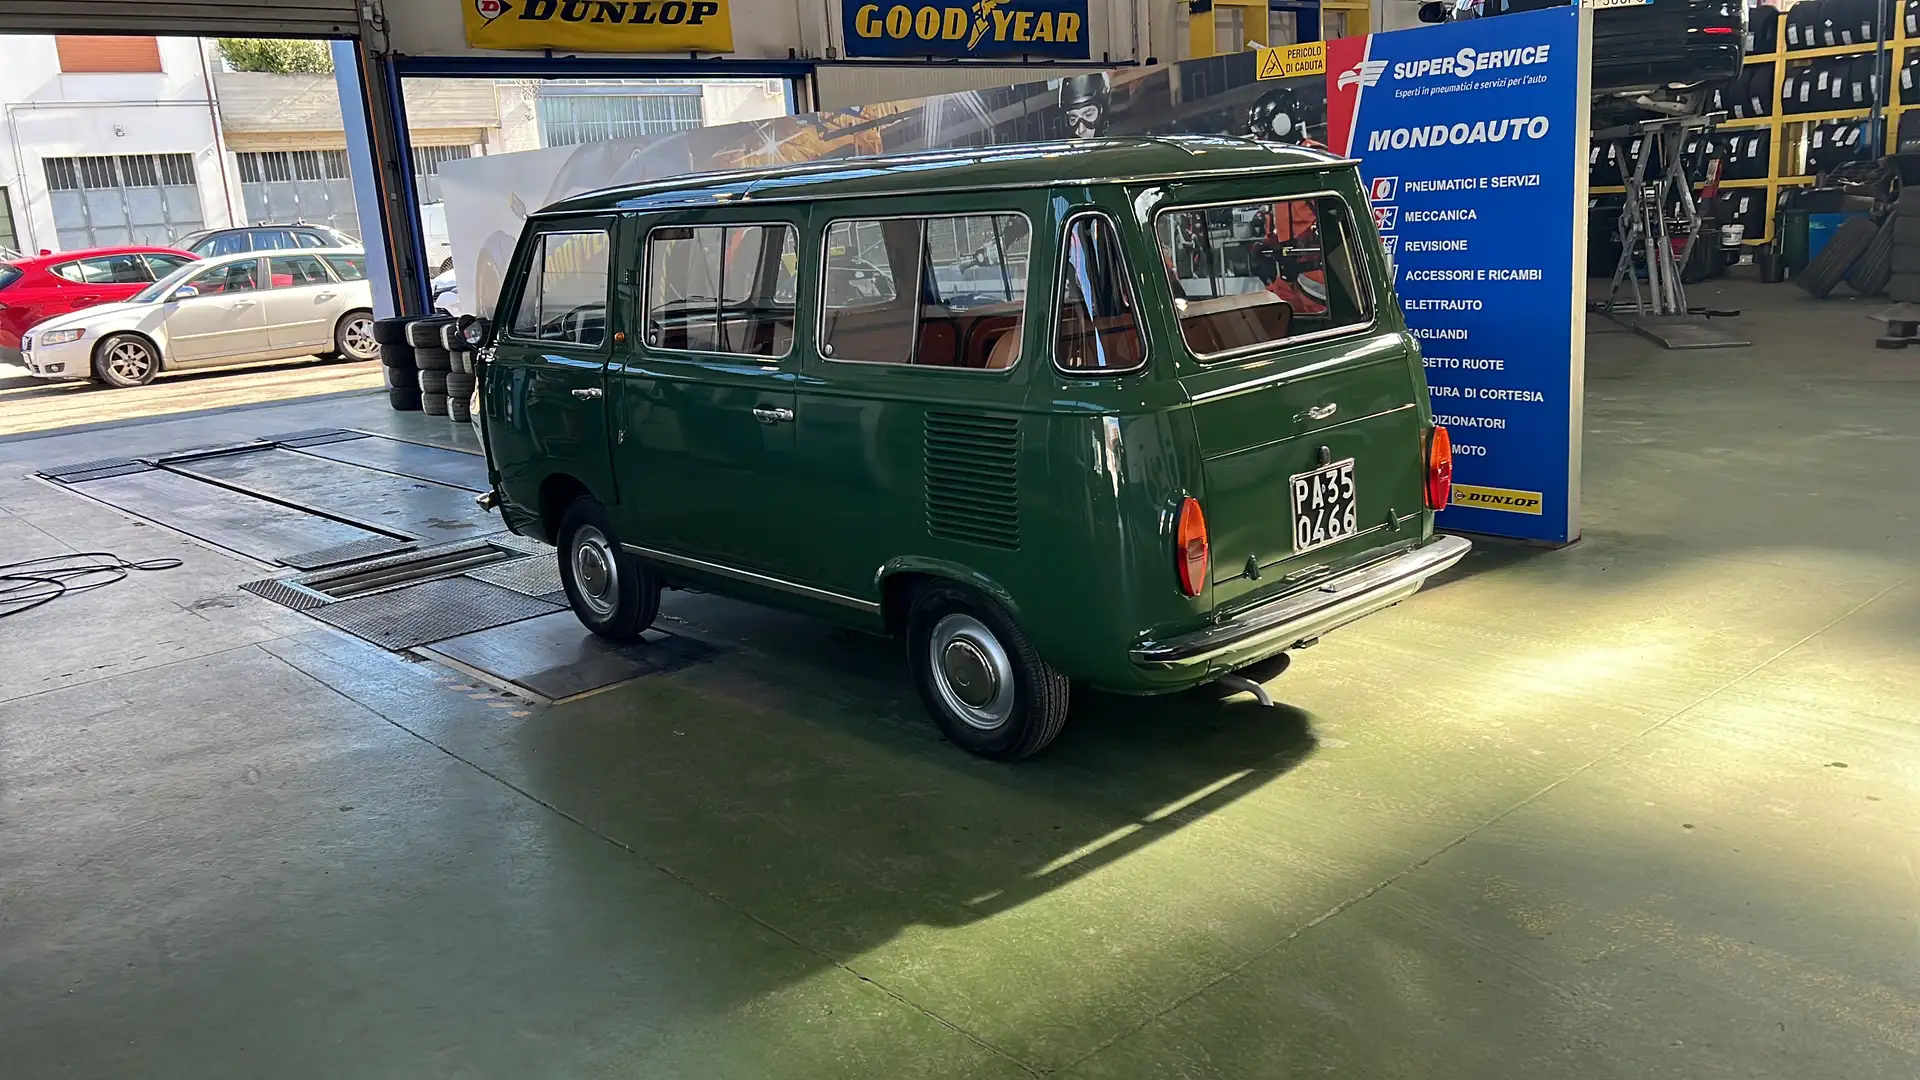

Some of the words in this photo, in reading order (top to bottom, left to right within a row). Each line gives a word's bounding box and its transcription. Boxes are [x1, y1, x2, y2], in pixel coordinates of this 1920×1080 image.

[517, 0, 719, 25] DUNLOP
[1287, 46, 1322, 60] PERICOLO
[1286, 63, 1293, 73] DI
[1295, 60, 1323, 72] CADUTA
[1395, 87, 1421, 99] Esperti
[1422, 86, 1430, 95] in
[1430, 81, 1474, 97] pneumatici
[1474, 82, 1479, 90] e
[1480, 78, 1506, 89] servizi
[1507, 77, 1522, 88] per
[1368, 116, 1550, 152] MONDOAUTO
[1405, 178, 1476, 193] PNEUMATICI
[1479, 177, 1488, 188] E
[1491, 174, 1540, 188] SERVIZI
[1405, 209, 1477, 222] MECCANICA
[1405, 240, 1468, 251] REVISIONE
[1405, 270, 1474, 281] ACCESSORI
[1477, 270, 1485, 280] E
[1488, 269, 1542, 280] RICAMBI
[1405, 299, 1483, 310] ELETTRAUTO
[1462, 358, 1504, 370] RUOTE
[1464, 388, 1477, 398] DI
[1479, 389, 1544, 402] CORTESIA
[1468, 493, 1539, 507] DUNLOP
[1298, 500, 1356, 549] 0466
